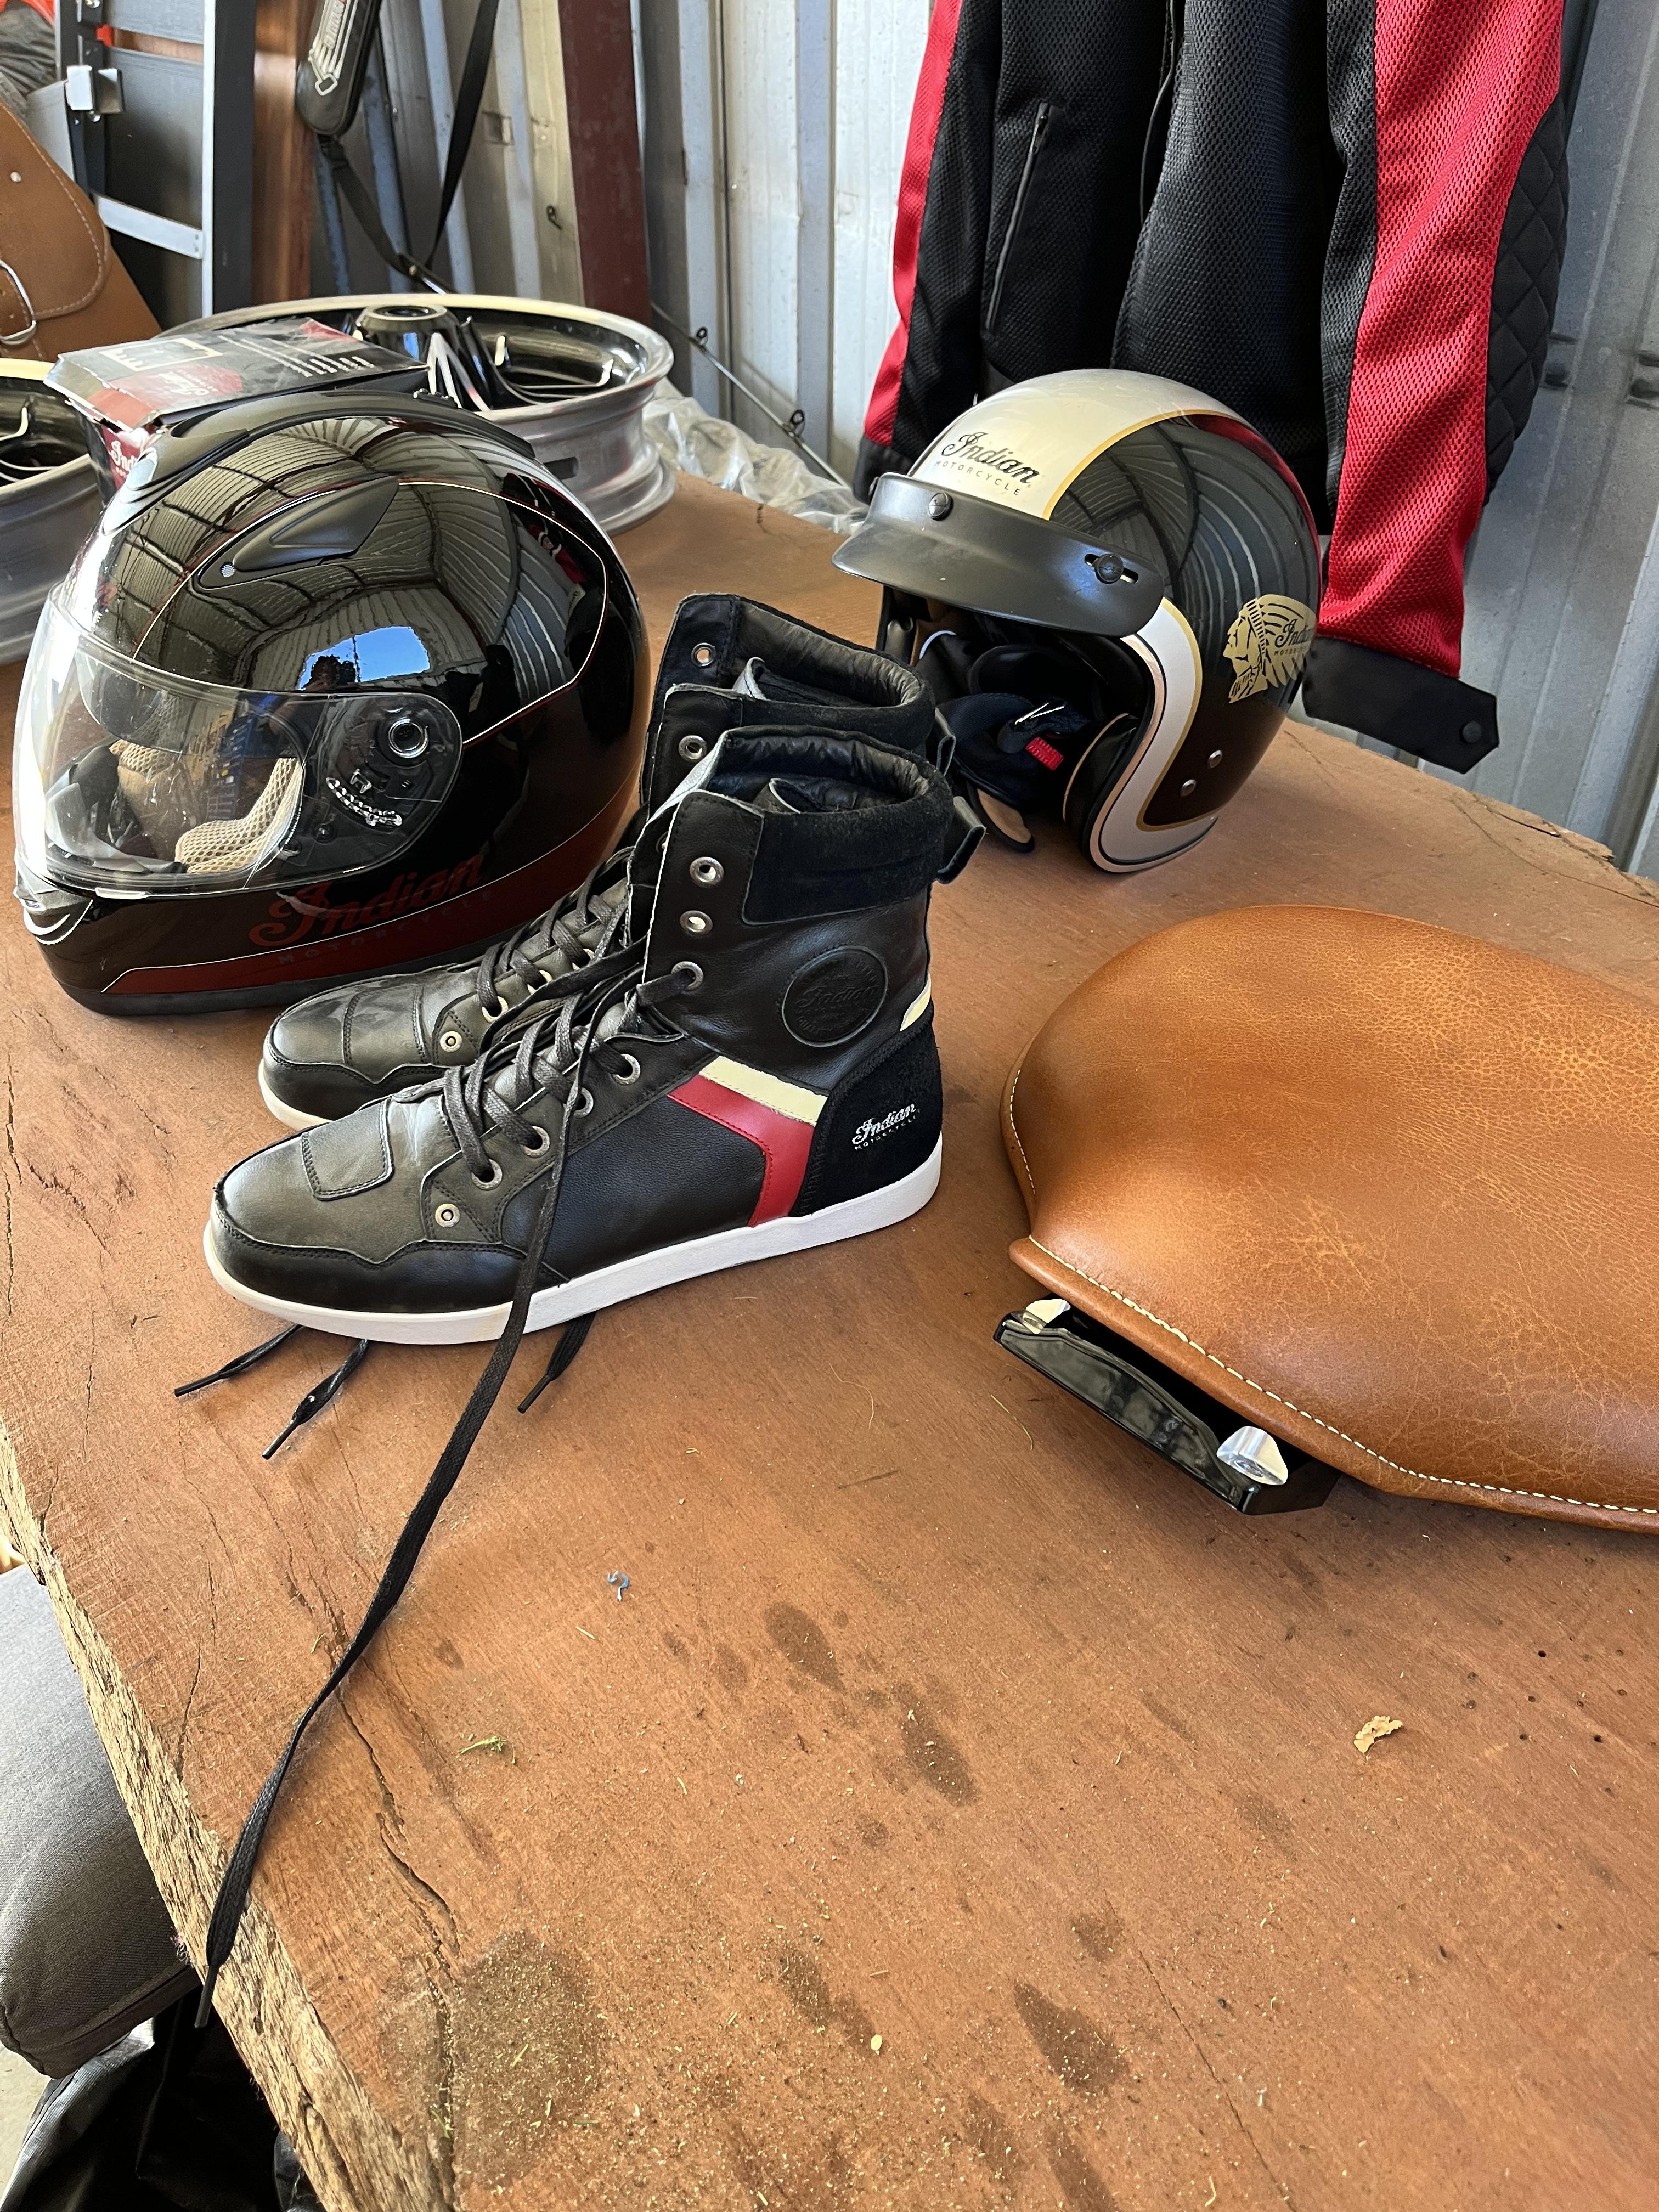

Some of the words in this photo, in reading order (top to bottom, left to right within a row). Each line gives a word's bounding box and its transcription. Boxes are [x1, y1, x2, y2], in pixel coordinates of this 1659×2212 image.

[110, 440, 138, 471] Ind
[934, 460, 1022, 496] MOTORCYCLE
[941, 432, 1040, 484] Indian
[248, 854, 484, 947] Indian
[277, 889, 493, 964] MOTORCYCLE
[851, 1103, 916, 1144] Indian
